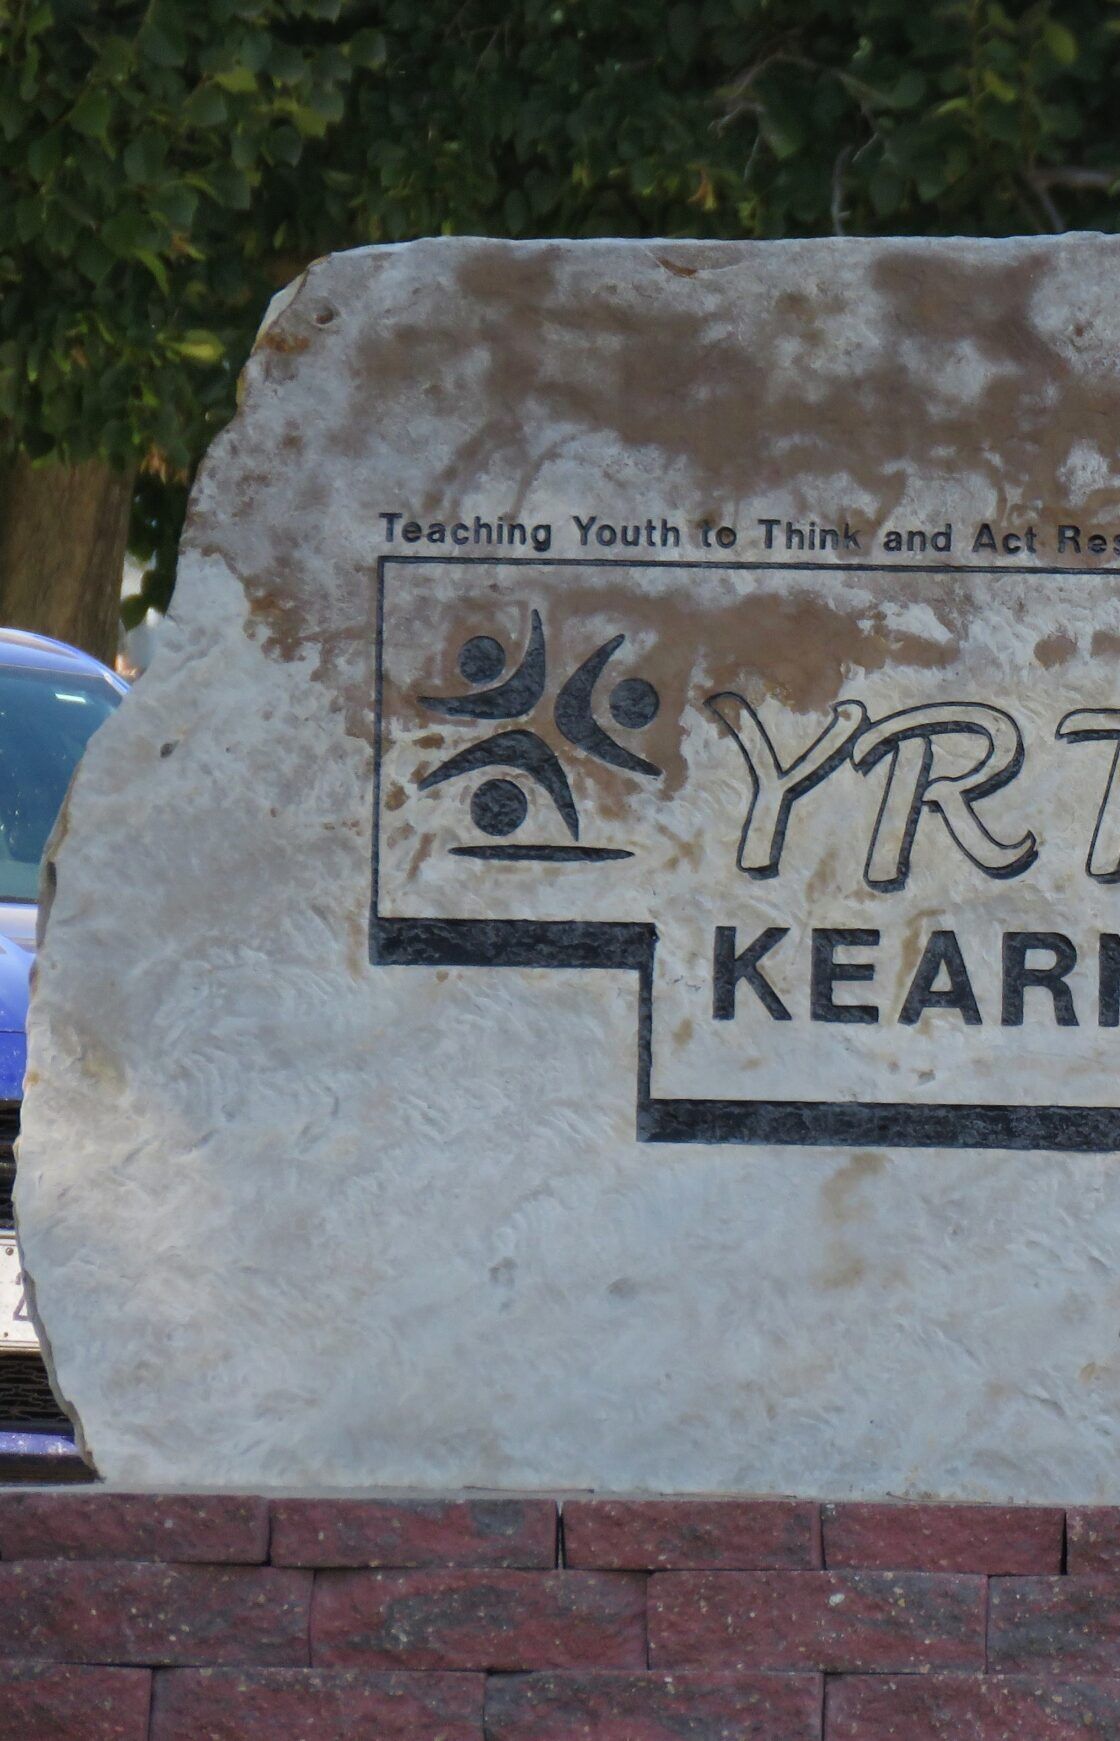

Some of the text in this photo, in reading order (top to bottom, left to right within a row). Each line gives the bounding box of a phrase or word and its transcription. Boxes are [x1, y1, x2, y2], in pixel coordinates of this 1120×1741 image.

[379, 512, 552, 553] Teaching
[573, 515, 681, 548] Youth
[702, 518, 738, 549] to
[758, 519, 861, 551] Think
[883, 523, 953, 553] and
[972, 523, 1037, 554] Act
